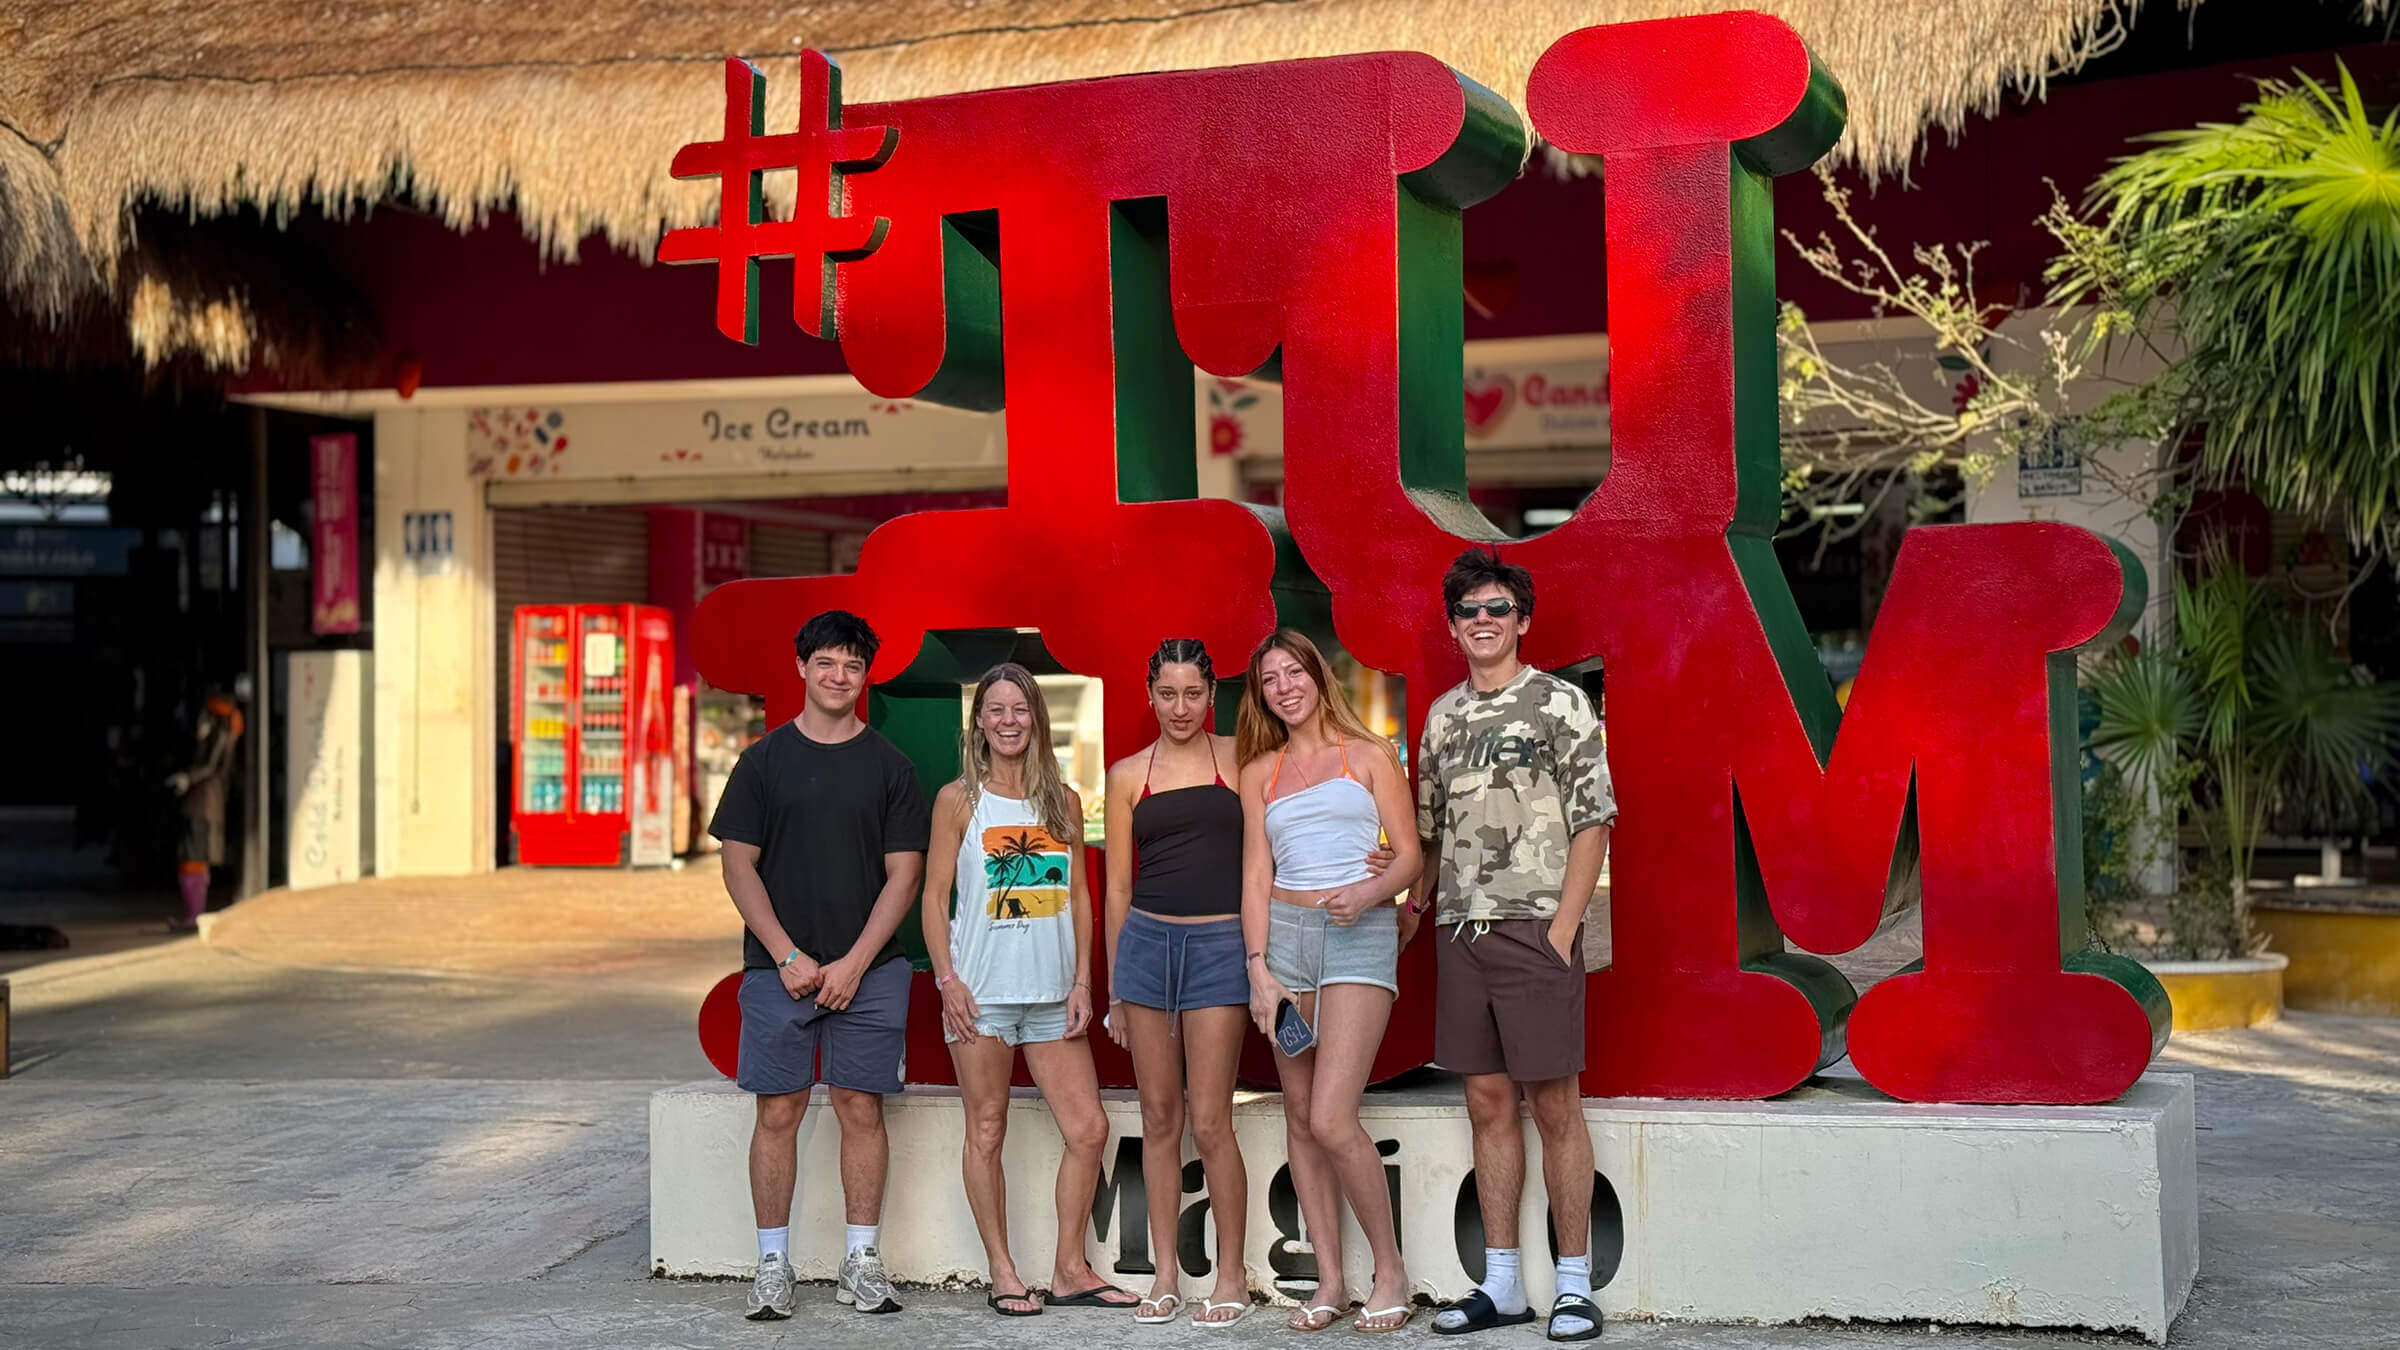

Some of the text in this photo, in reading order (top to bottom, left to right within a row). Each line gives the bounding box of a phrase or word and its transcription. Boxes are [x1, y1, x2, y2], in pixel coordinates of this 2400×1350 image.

[1523, 372, 1611, 407] Cand
[702, 407, 870, 442] Ice Cream
